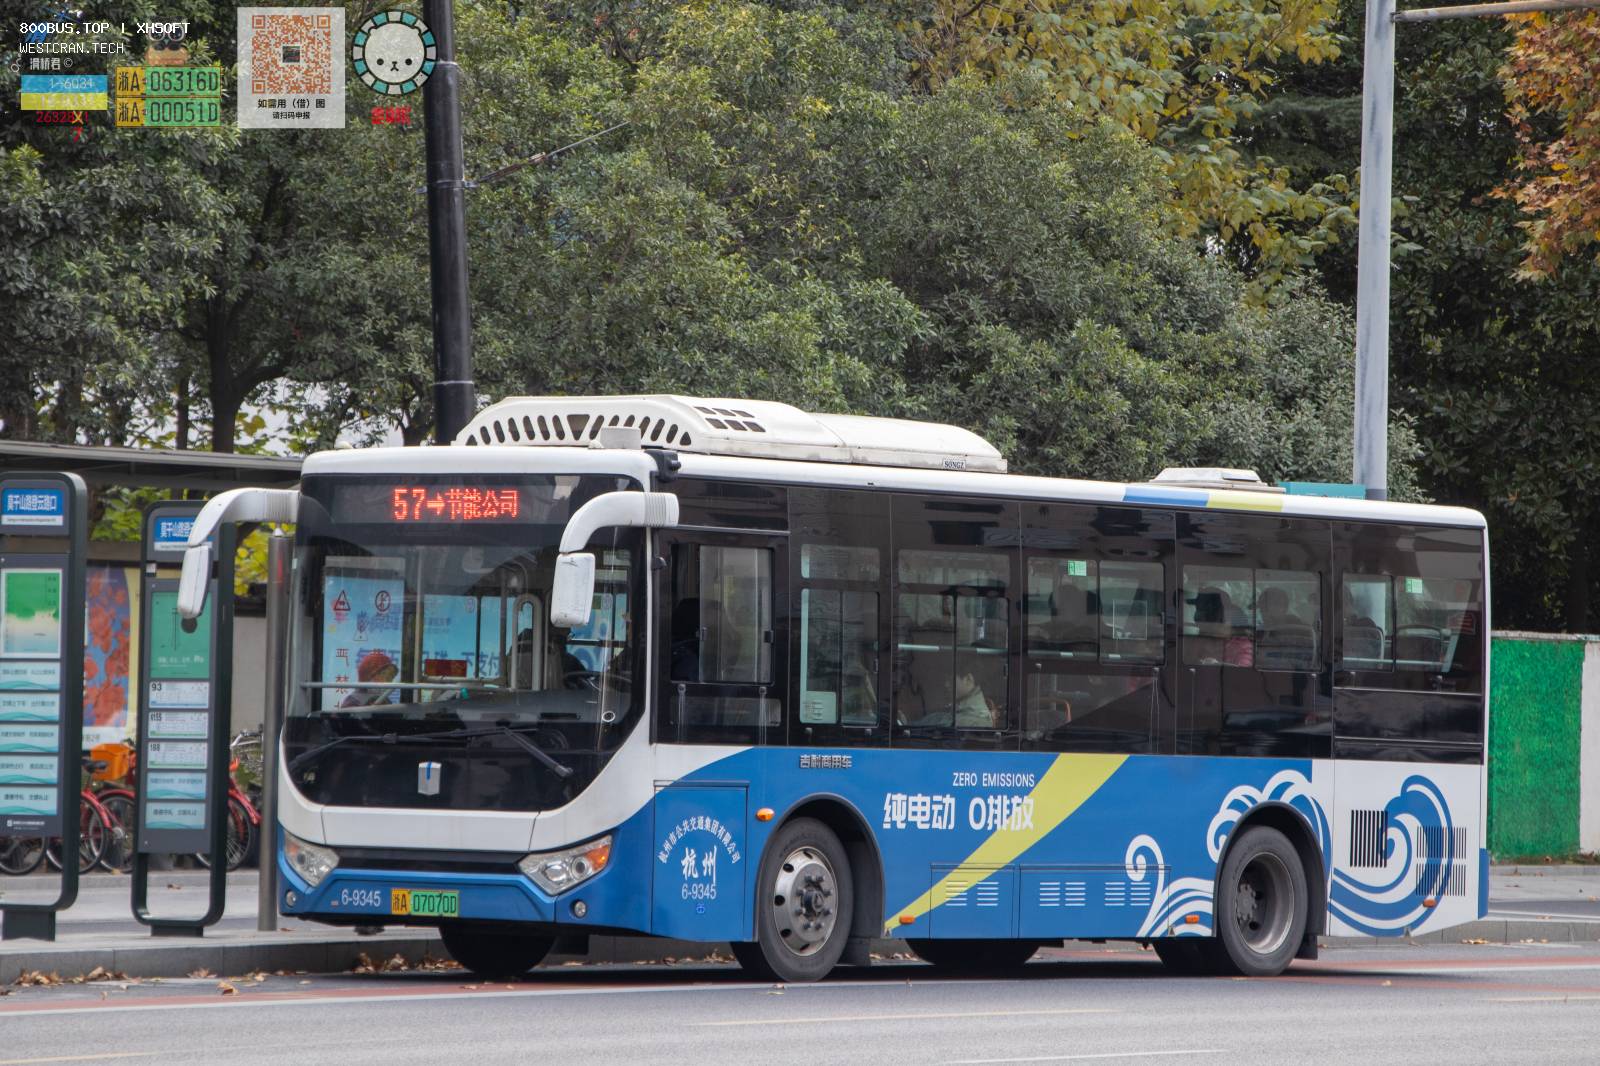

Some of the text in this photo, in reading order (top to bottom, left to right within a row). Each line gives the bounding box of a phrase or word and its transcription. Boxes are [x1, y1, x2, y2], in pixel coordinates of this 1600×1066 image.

[394, 488, 518, 520] 57 节能公司
[953, 772, 1035, 787] ZERO EMISSIONS
[883, 792, 956, 830] 纯电动
[681, 845, 717, 886] 杭州
[341, 888, 381, 907] 6-9345
[681, 883, 717, 900] 6-9345
